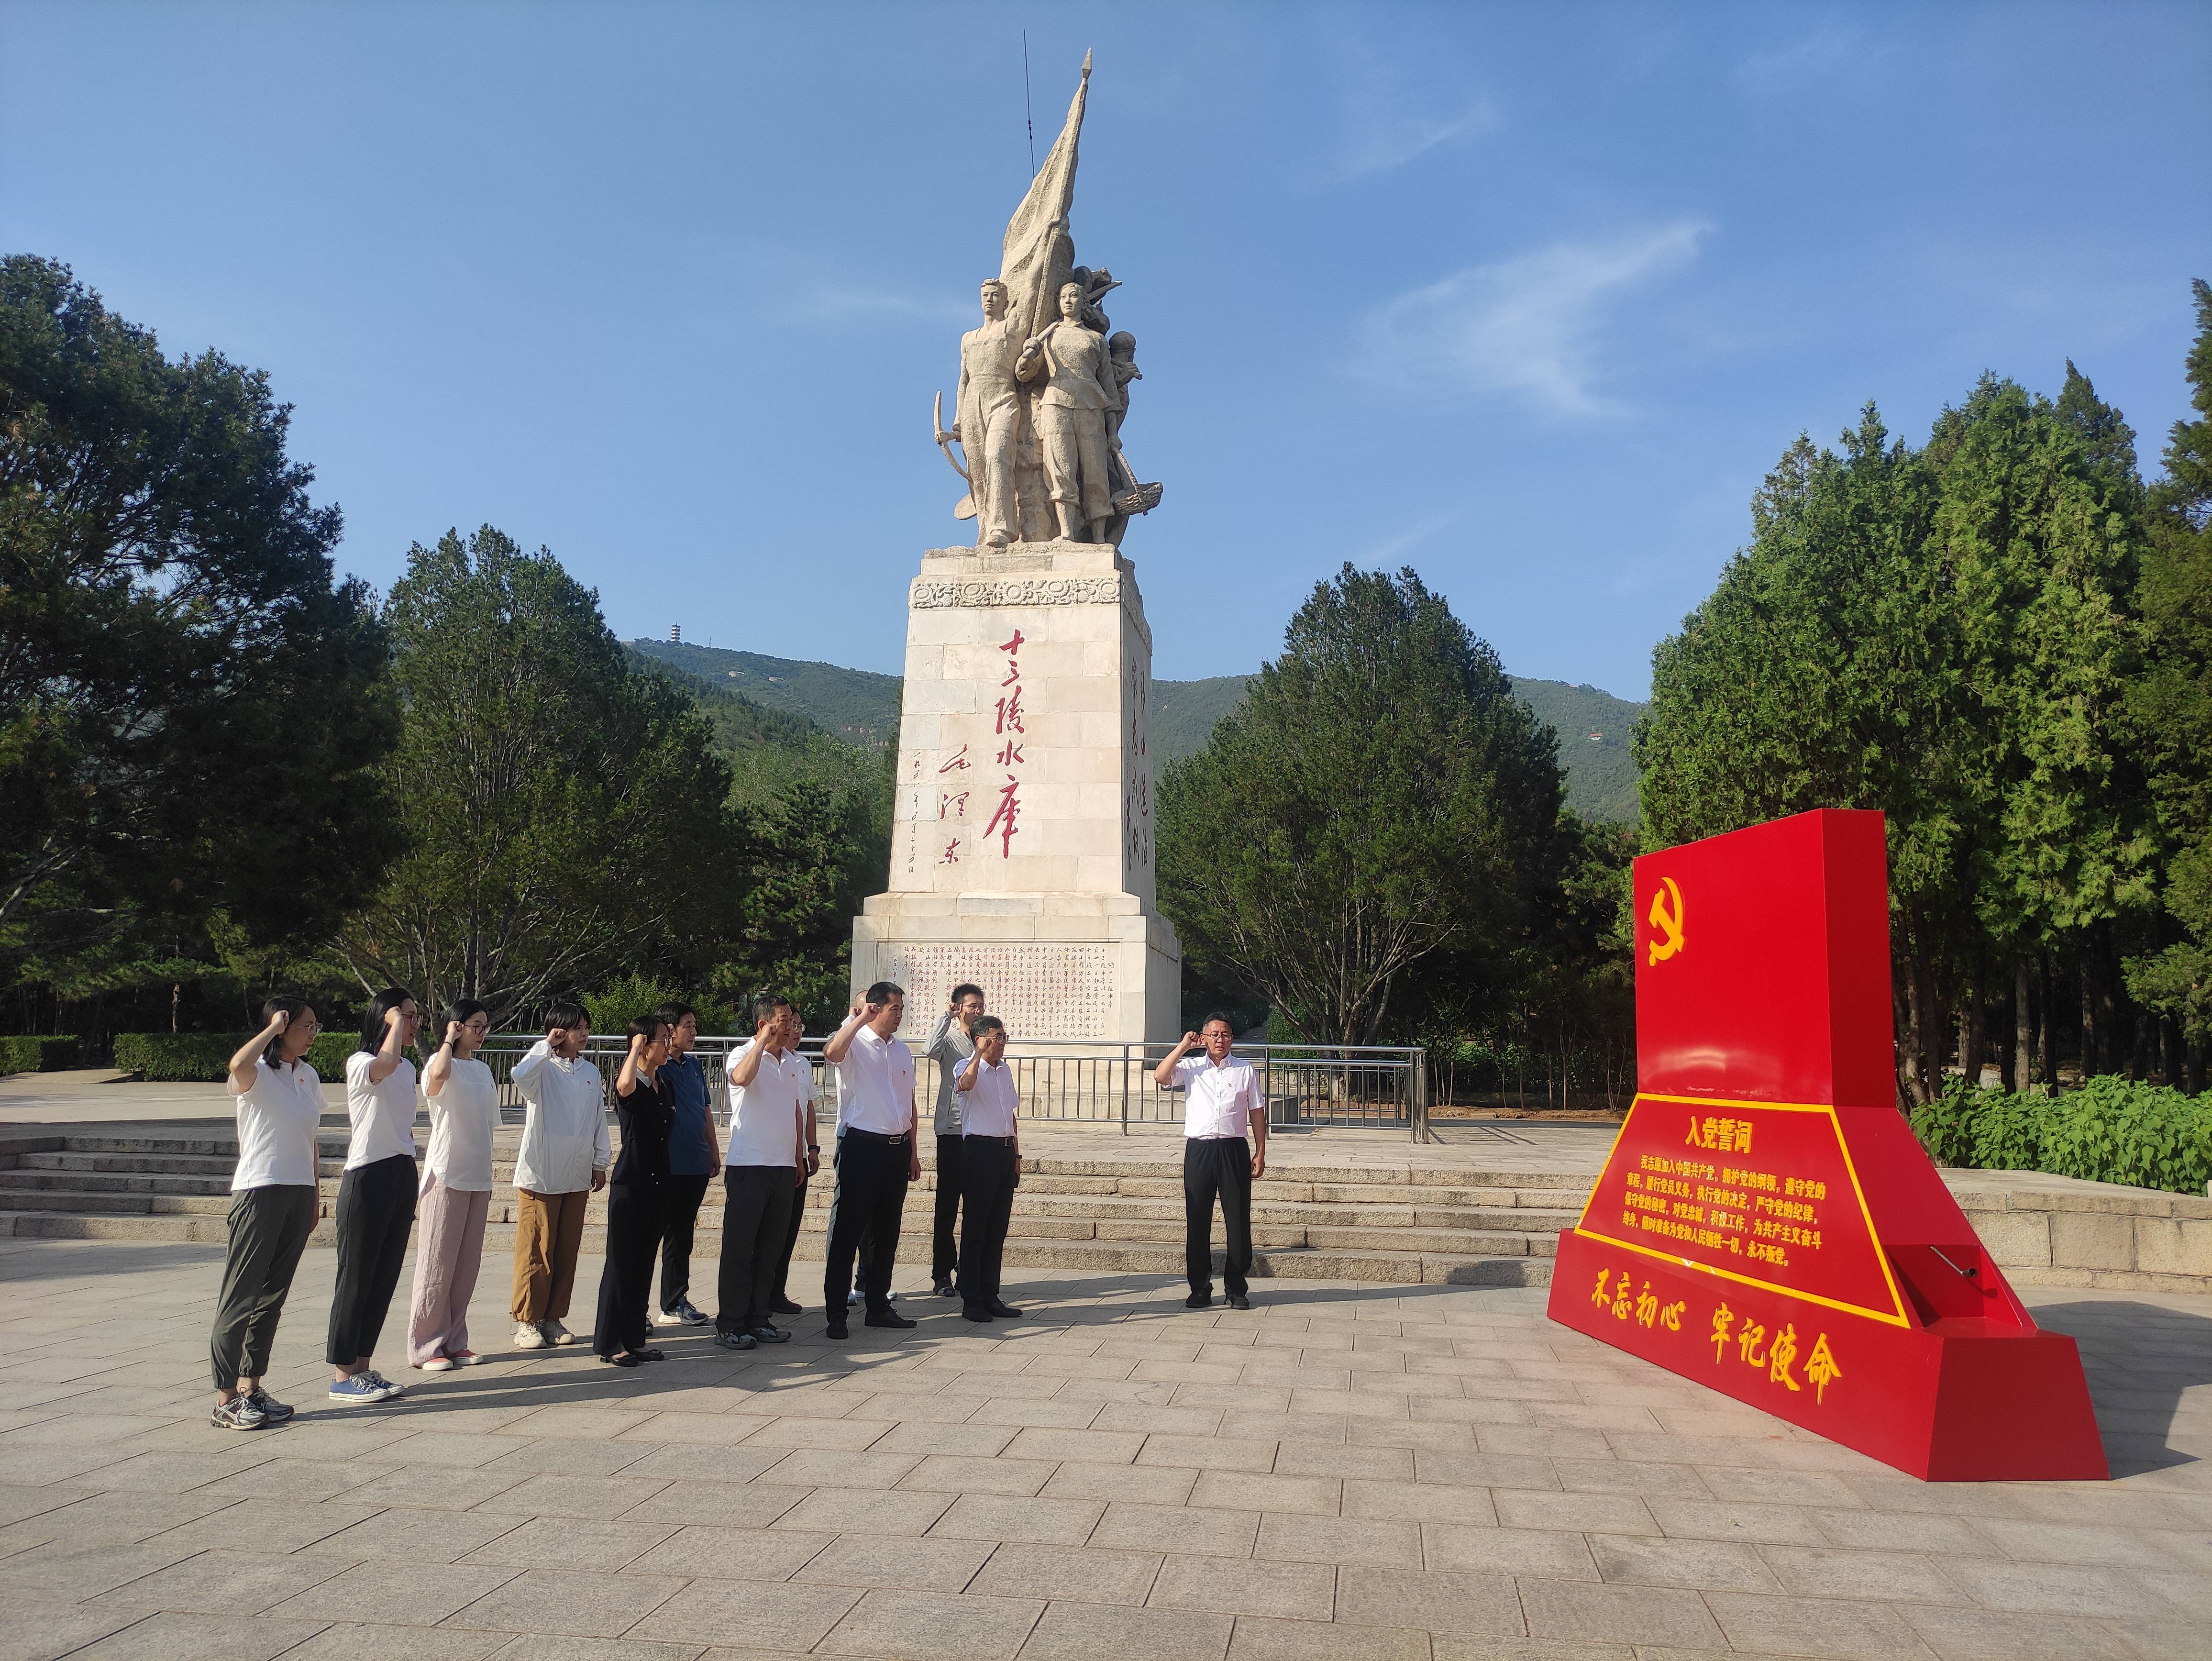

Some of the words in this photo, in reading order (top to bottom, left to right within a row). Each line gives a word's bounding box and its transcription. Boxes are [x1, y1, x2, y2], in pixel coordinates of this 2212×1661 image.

[983, 628, 1026, 859] 十三陵水库
[1685, 1114, 1754, 1154] 入党誓词
[1592, 1268, 1687, 1332] 不忘初心
[1711, 1301, 1842, 1406] 牢记使命
